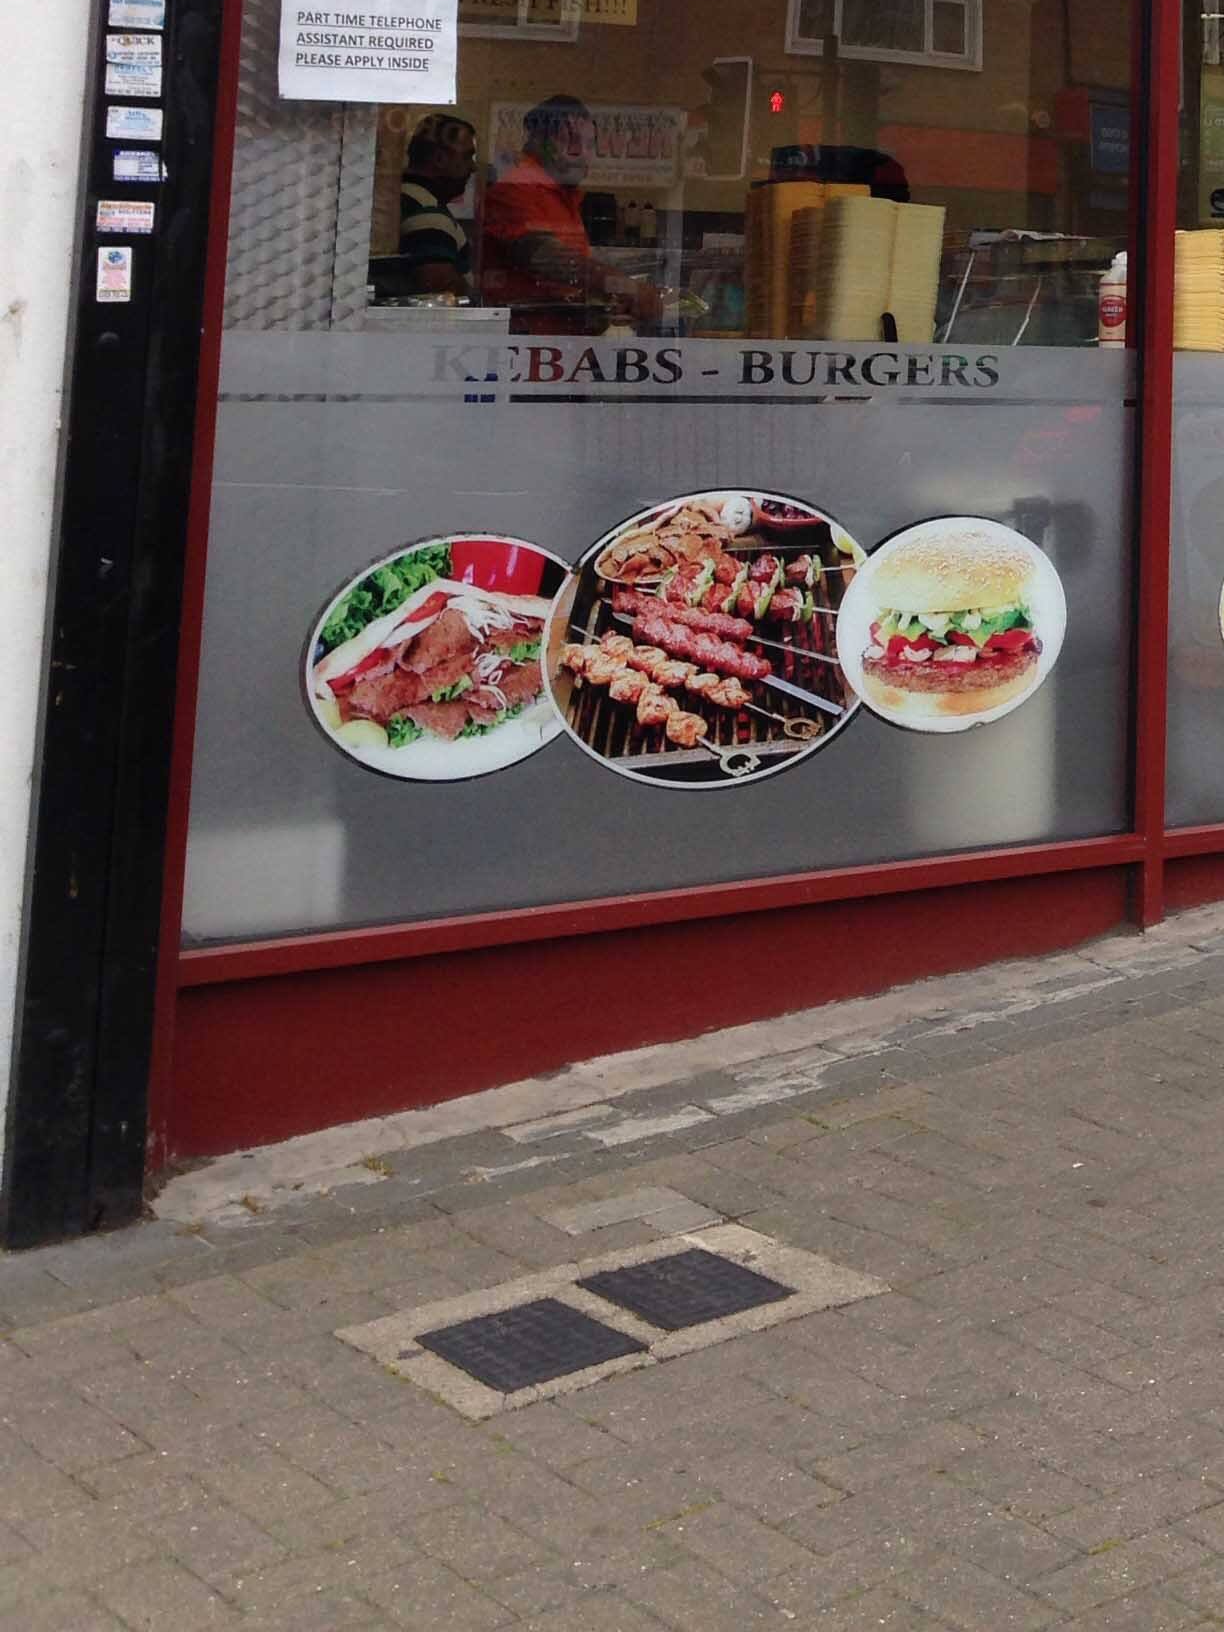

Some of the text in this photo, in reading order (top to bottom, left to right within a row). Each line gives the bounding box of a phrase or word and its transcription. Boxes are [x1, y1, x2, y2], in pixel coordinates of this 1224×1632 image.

[297, 11, 442, 30] PART TIME TELEPHONE
[296, 32, 434, 50] ASSISTANT REQUIRED
[295, 53, 430, 70] PLEASE APPLY INSIDE
[431, 344, 684, 385] KEBABS
[738, 350, 1001, 388] BURGERS
